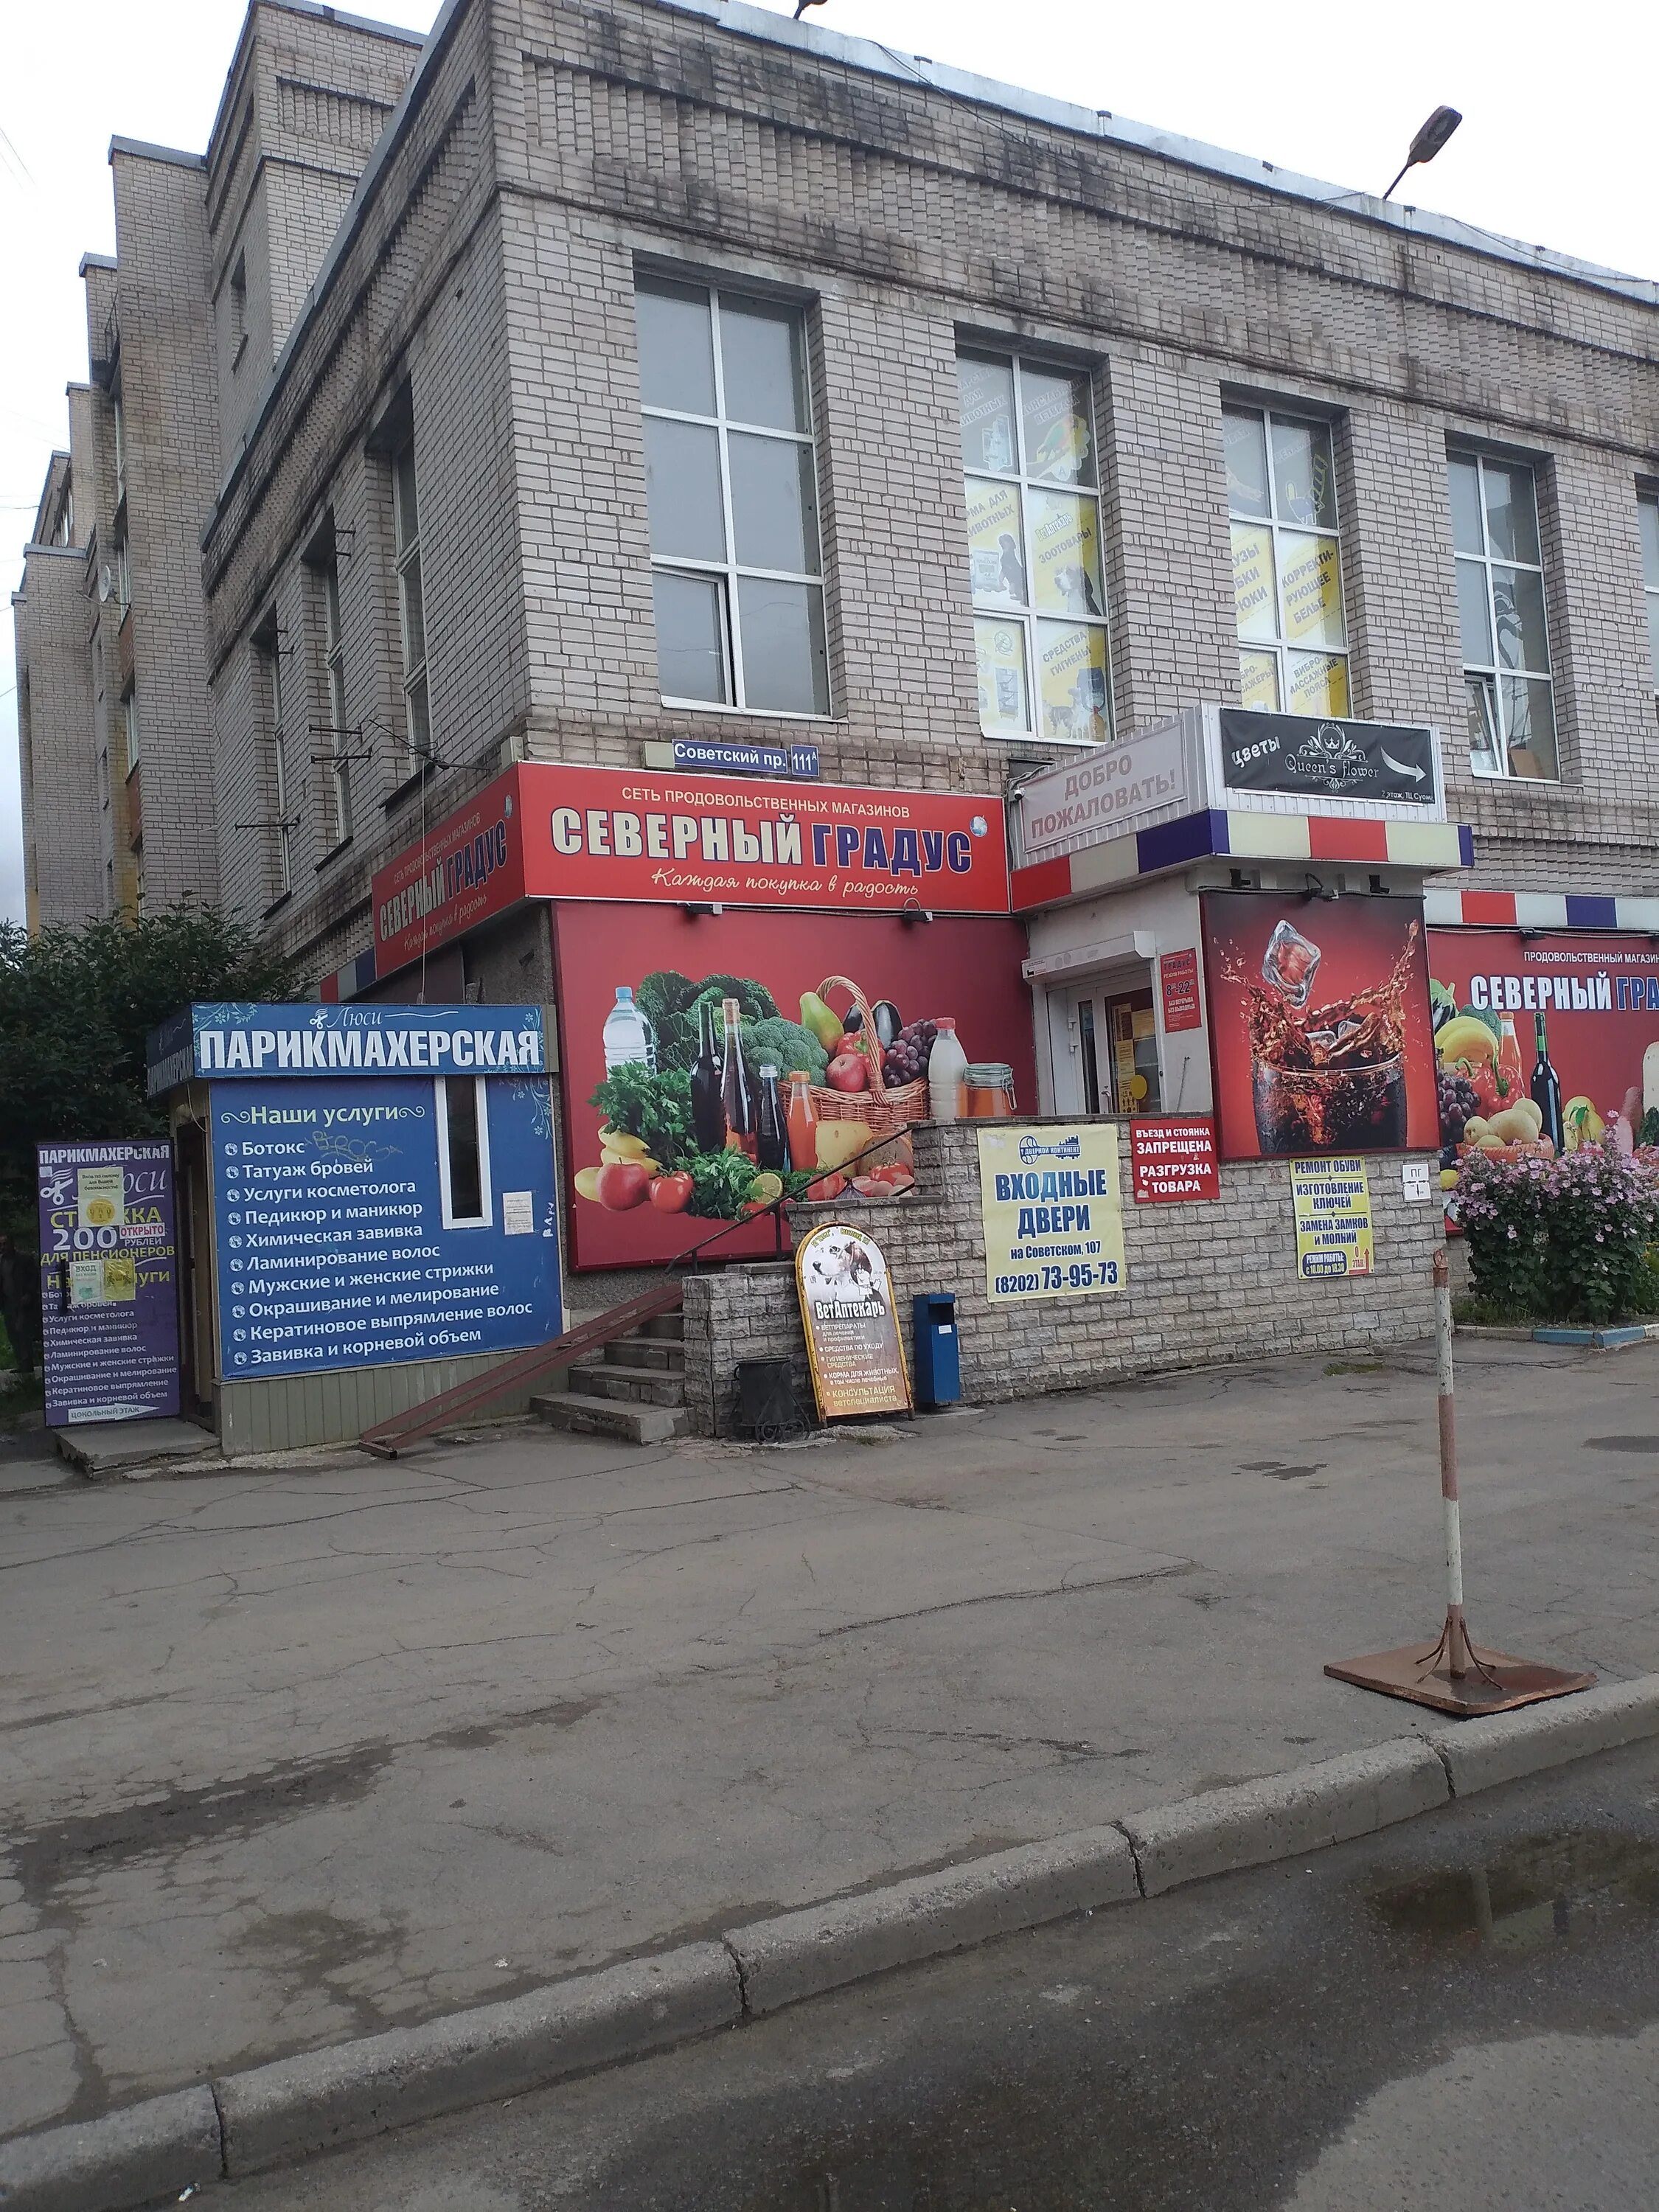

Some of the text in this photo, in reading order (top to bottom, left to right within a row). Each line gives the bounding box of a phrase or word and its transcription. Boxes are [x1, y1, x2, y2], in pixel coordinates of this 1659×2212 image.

[1038, 527, 1091, 564] ЗООТОВАРЫ
[1281, 550, 1334, 588] КОРРЕКТИ-
[1286, 571, 1331, 606] РУЮЩЕЕ
[1293, 598, 1326, 625] БЕЛЬЕ
[1043, 631, 1087, 662] СРЕДСТВА
[1050, 646, 1091, 676] ГИГИЕНЫ
[674, 742, 786, 769] Советский пр.
[1285, 753, 1337, 775] Queen's
[1065, 754, 1132, 801] ДОБРО
[622, 786, 911, 818] СЕТЬ ПРОДОВОЛЬСТВЕННЫХ МАГАЗИНОВ
[1032, 769, 1175, 838] ПОЖАЛОВАТЬ!
[1405, 792, 1413, 800] ТЦ
[451, 812, 481, 843] МАГАЗИНОВ
[550, 805, 973, 877] СЕВЕРНЫЙ ГРАДУС
[380, 819, 507, 942] СЕВЕРНЫЙ ГРАДУС
[651, 867, 919, 897] Каждая покупка в радость
[1523, 951, 1623, 963] ПРОДОВОЛЬСТВЕННЫЙ
[1471, 970, 1659, 1011] СЕВЕРНЫЙ ГРА
[327, 1006, 383, 1028] Люси
[200, 1029, 540, 1068] ПАРИКМАХЕРСКАЯ
[251, 1105, 400, 1128] Наши услуги
[1136, 1127, 1210, 1139] ВЪЕЗД И СТОЯНКА
[39, 1145, 169, 1164] ПАРИКМАХЕРСКАЯ
[242, 1141, 305, 1156] Ботокс
[1136, 1140, 1212, 1155] ЗАПРЕЩЕНА
[243, 1159, 374, 1181] Татуаж бровей
[1139, 1163, 1211, 1178] РАЗГРУЗКА
[1295, 1160, 1332, 1174] РЕМОНТ
[1333, 1159, 1361, 1172] ОБУВИ
[1411, 1168, 1422, 1178] ПГ
[244, 1180, 417, 1203] Услуги косметолога
[995, 1169, 1107, 1203] ВХОДНЫЕ
[1152, 1180, 1201, 1194] ТОВАРА
[1296, 1181, 1364, 1196] ИЗГОТОВЛЕНИЕ
[1312, 1194, 1352, 1210] КЛЮЧЕЙ
[246, 1203, 423, 1228] Педикюр и маникюр
[1018, 1204, 1091, 1239] ДВЕРИ
[1300, 1217, 1368, 1232] ЗАМЕНА ЗАМКОВ
[53, 1226, 116, 1251] 200
[121, 1225, 164, 1237] ОТКРЫТО
[246, 1225, 423, 1248] Химическая завивка
[1314, 1231, 1357, 1245] и МОЛНИЙ
[125, 1237, 161, 1246] РУБЛЕЙ
[1010, 1241, 1101, 1259] на Советском, 107
[41, 1246, 175, 1266] ДЛЯ ПЕНСИОНЕРОВ
[247, 1245, 440, 1272] Ламинирование волос
[75, 1265, 97, 1273] ВХОД
[249, 1263, 494, 1295] Мужские и женские стрижки
[995, 1261, 1118, 1294] (8202) 73-95-73
[249, 1284, 500, 1320] Окрашивание и мелирование
[815, 1300, 885, 1320] ВетАптекарь
[79, 1311, 134, 1320] косметолога
[251, 1301, 533, 1341] Кератиновое выпрямление волос
[50, 1326, 89, 1335] Педикюр
[98, 1323, 137, 1332] маникюр
[821, 1322, 866, 1331] ВЕТПРЕПАРАТЫ
[49, 1334, 137, 1347] Химическая завивка
[251, 1329, 482, 1365] Завивка и корневой объем
[50, 1348, 119, 1359] Ламинирование
[51, 1361, 91, 1371] Мужские
[100, 1359, 136, 1367] женские
[138, 1355, 174, 1365] стрижки
[827, 1354, 873, 1362] ГИГИЕНИЧЕСКИЕ
[52, 1372, 111, 1383] Окрашивание
[120, 1366, 177, 1377] мелирование
[829, 1371, 849, 1379] КОРМА
[52, 1380, 169, 1396] Кератиновое выпрямление
[832, 1385, 895, 1398] КОНСУЛЬТАЦИЯ
[52, 1397, 88, 1408] Завивка
[97, 1392, 138, 1404] корневой
[139, 1391, 167, 1399] объем
[833, 1395, 897, 1407] ветспециалиста
[71, 1406, 140, 1419] ЦОКОЛЬНЫЙ ЭТАЖ
